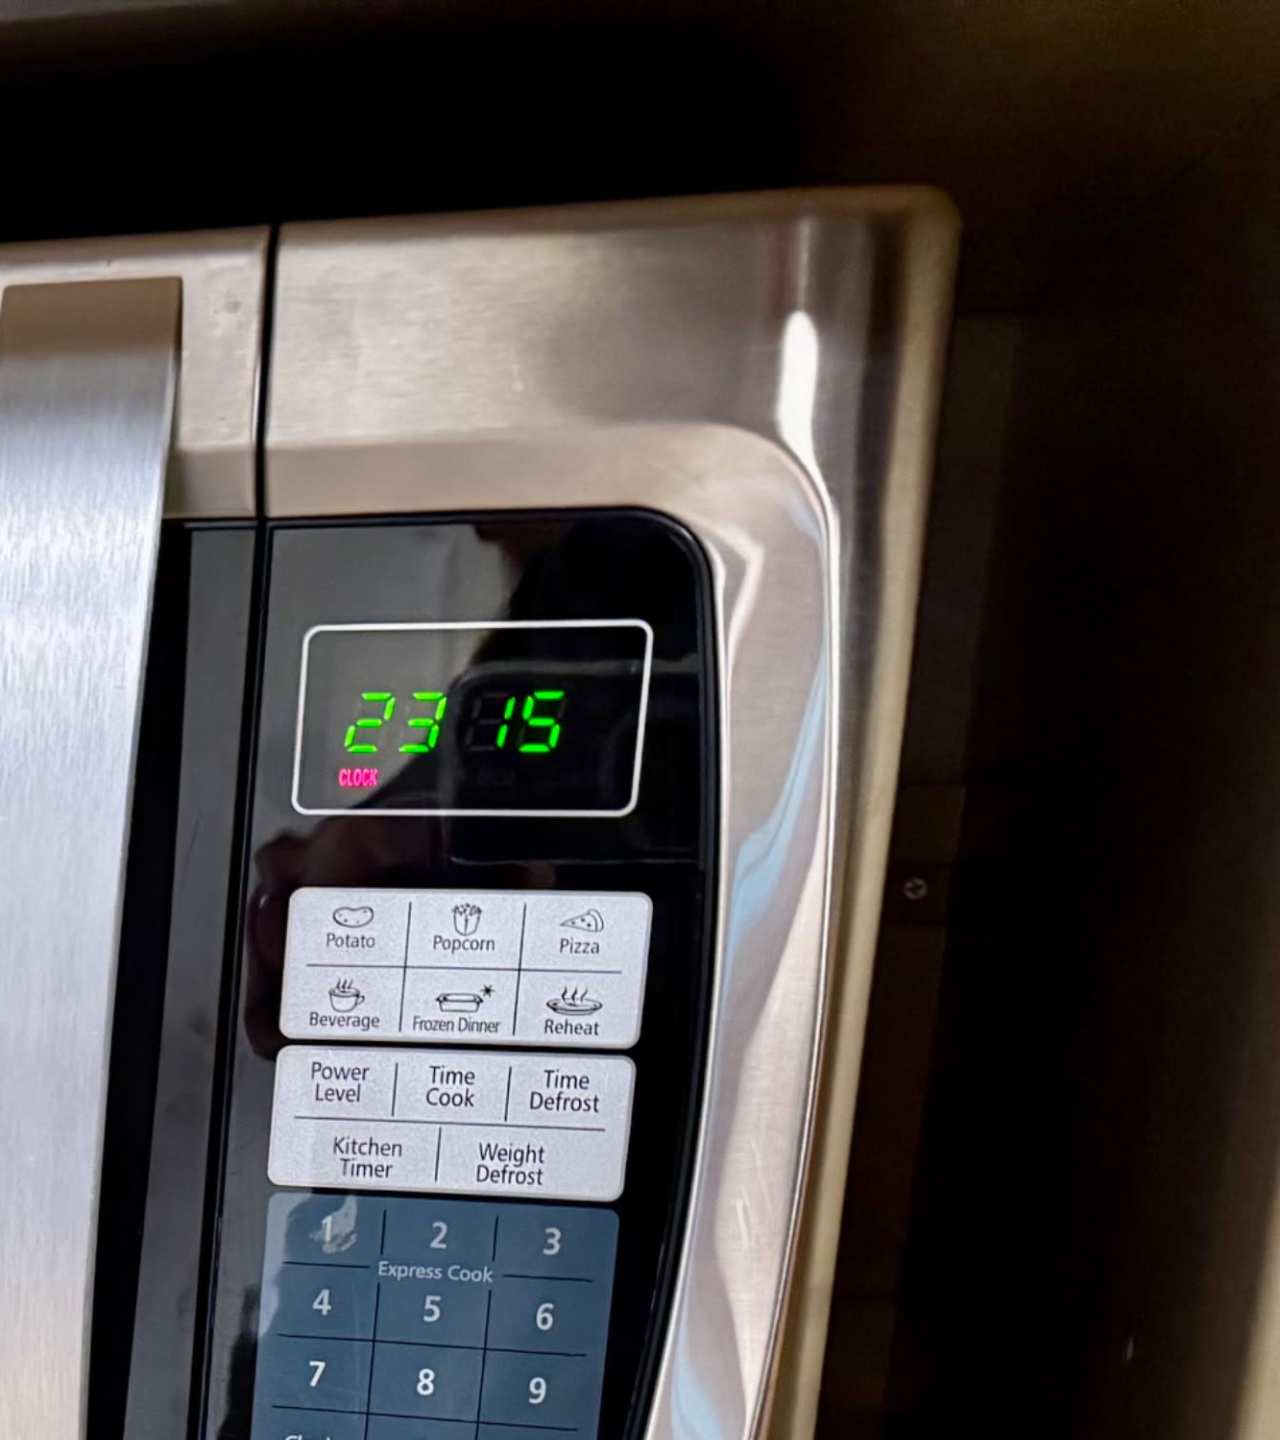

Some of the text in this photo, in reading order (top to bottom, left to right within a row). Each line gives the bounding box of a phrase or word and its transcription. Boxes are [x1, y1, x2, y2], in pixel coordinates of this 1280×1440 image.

[338, 768, 379, 787] CLOCK
[325, 933, 376, 949] Potato
[432, 935, 496, 953] Popcorn
[559, 938, 600, 955] Pizza
[309, 1012, 381, 1031] Beverage
[412, 1015, 501, 1034] Frozen Dinner
[543, 1019, 600, 1036] Reheat
[310, 1061, 370, 1082] Power
[429, 1065, 476, 1086] Time
[543, 1069, 590, 1091] Time
[314, 1084, 362, 1103] Level
[425, 1088, 475, 1108] Cook
[529, 1092, 600, 1114] Defrost
[333, 1136, 403, 1158] Kitchen
[478, 1142, 545, 1165] Weight
[339, 1158, 393, 1179] Timer
[476, 1165, 544, 1186] Defrost
[321, 1215, 334, 1243] 1
[429, 1221, 449, 1249] 2
[542, 1227, 562, 1255] 3
[377, 1260, 494, 1284] Express Cook
[312, 1288, 332, 1316] 4
[423, 1295, 441, 1322] 5
[535, 1303, 554, 1331] 6
[308, 1361, 326, 1387] 7
[416, 1369, 435, 1396] 8
[528, 1376, 547, 1404] 9
